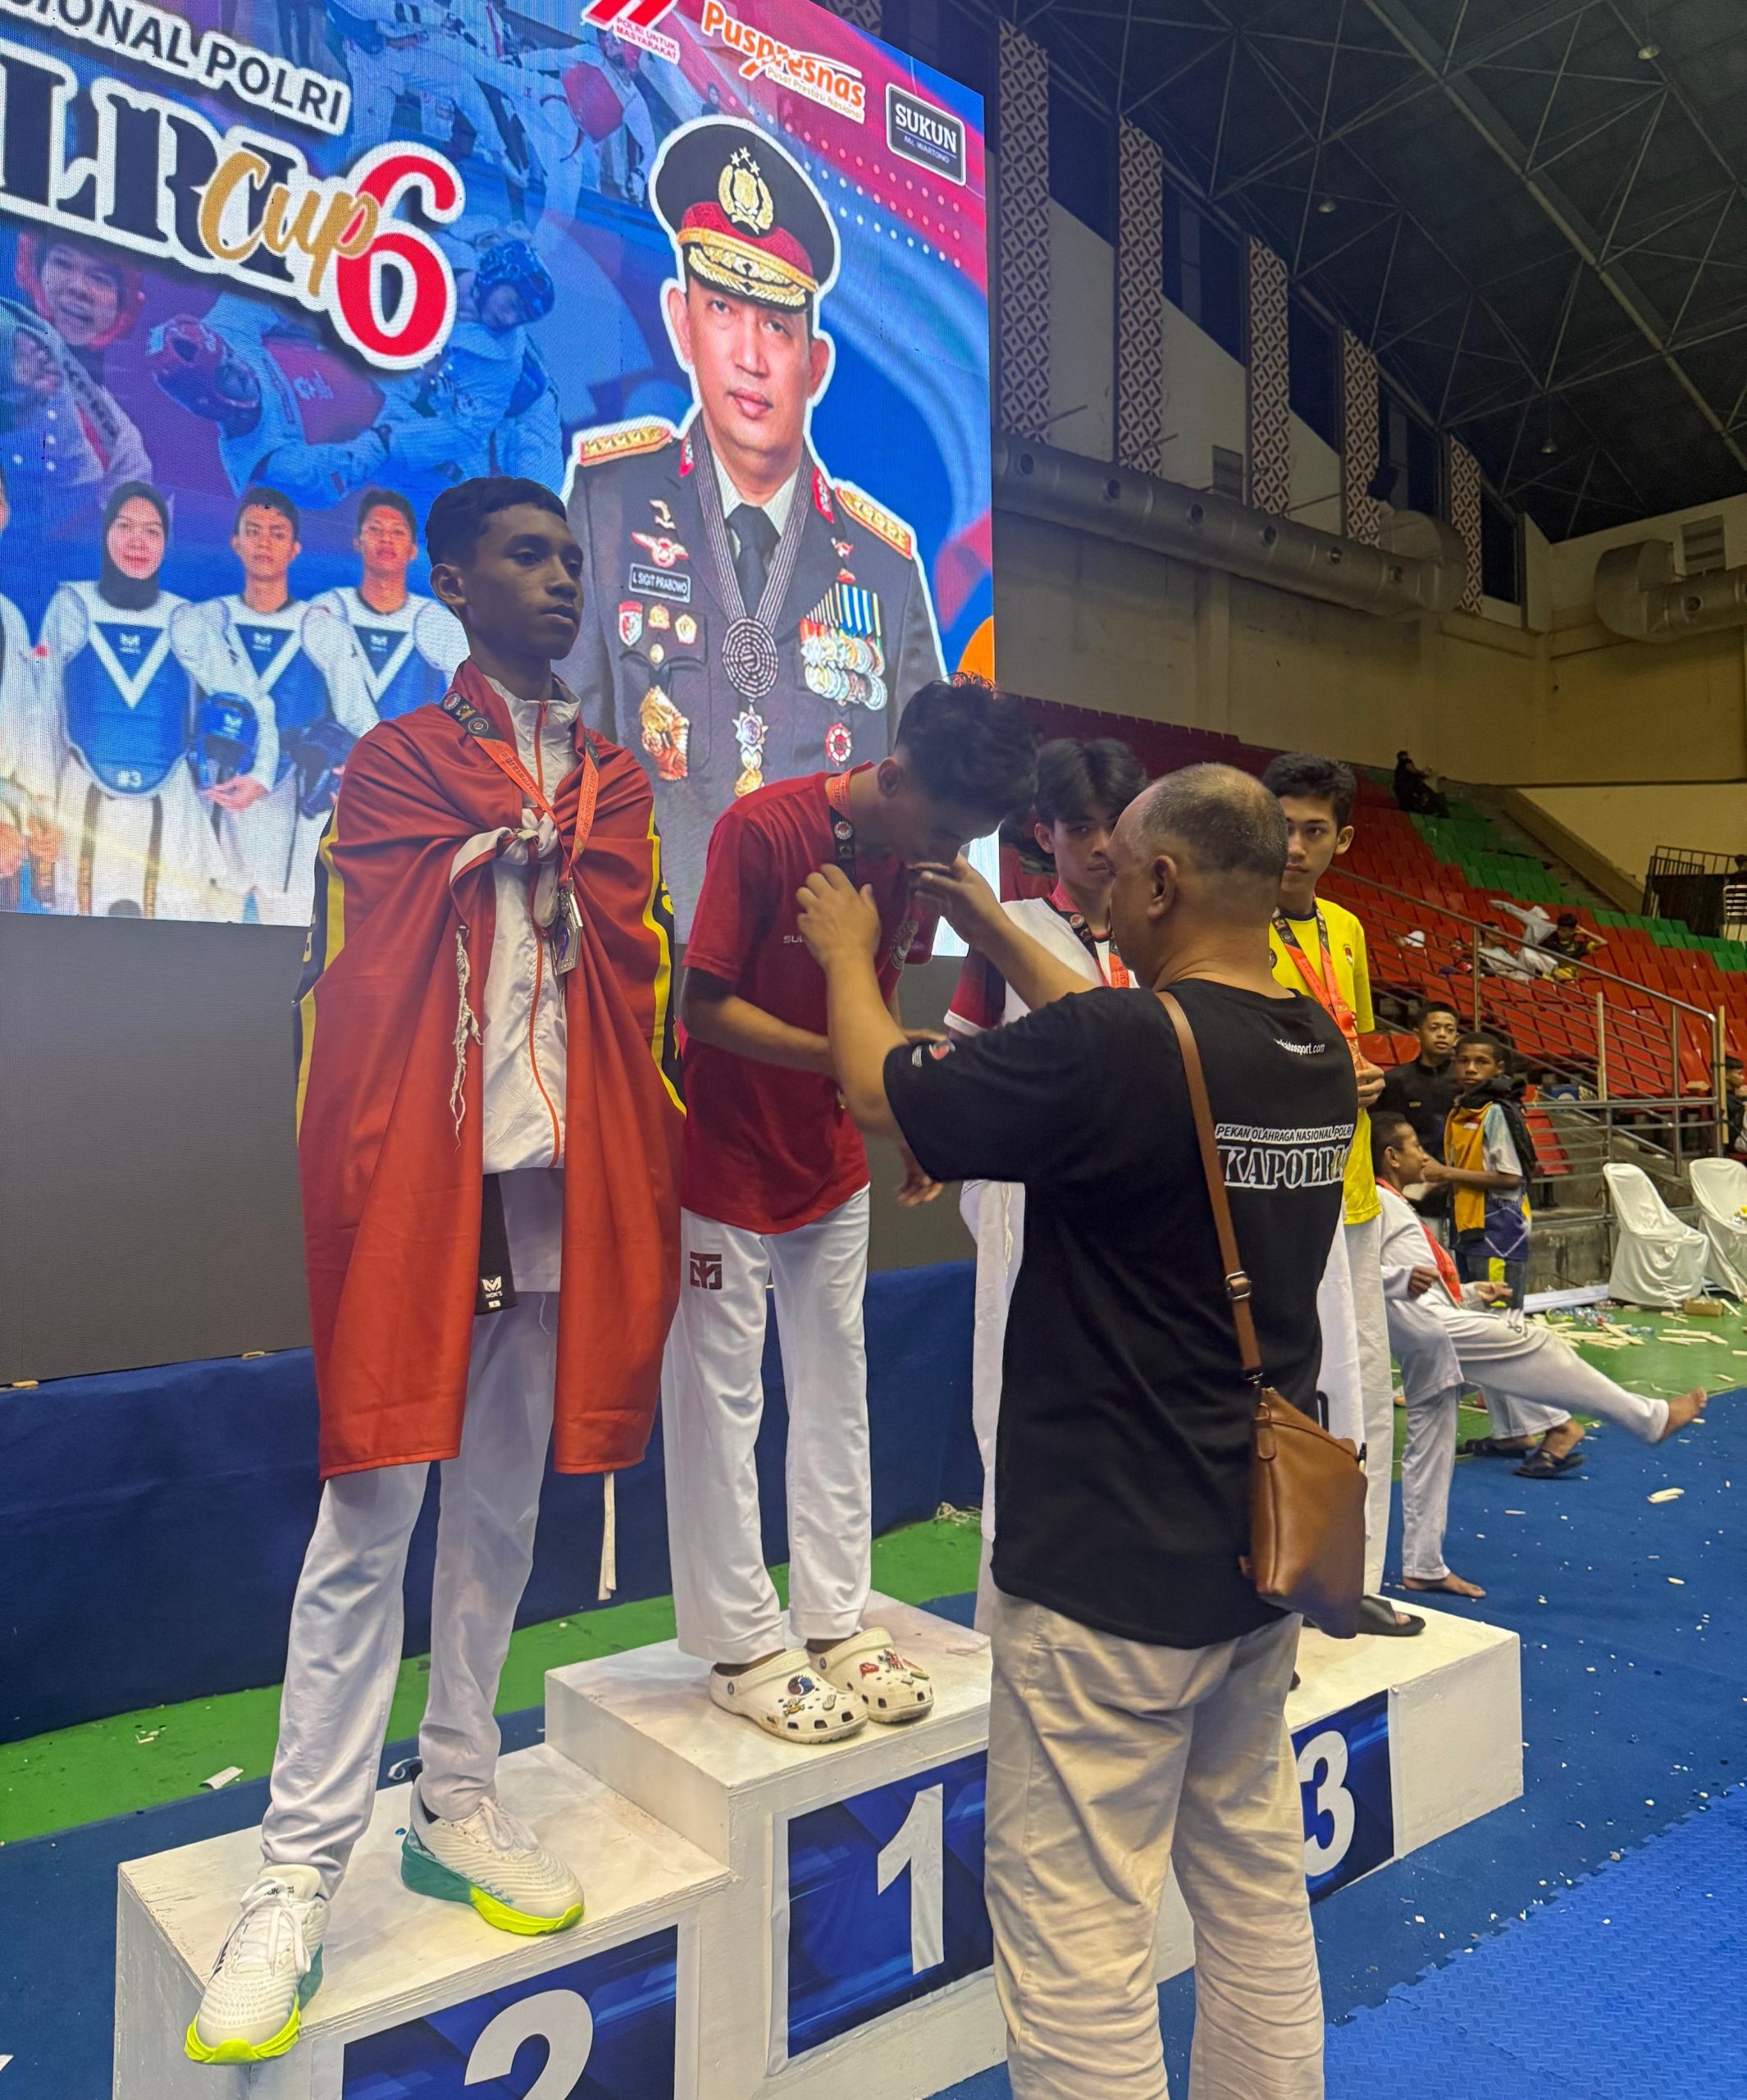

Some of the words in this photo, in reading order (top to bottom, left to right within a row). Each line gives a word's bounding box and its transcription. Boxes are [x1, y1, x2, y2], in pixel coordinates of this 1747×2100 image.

[11, 0, 189, 68] ONAL
[206, 41, 344, 126] POLRI
[616, 25, 677, 59] MASYARAKAT
[704, 1, 862, 107] Puspresnas
[895, 103, 958, 154] SUKUN
[198, 151, 379, 297] Cup
[335, 154, 458, 357] 6
[1216, 1125, 1250, 1139] PEKAN
[1252, 1128, 1294, 1142] OLAHRAGA
[1295, 1126, 1334, 1142] NASIONAL
[1297, 1729, 1356, 1877] 3
[878, 1783, 945, 1975] 1
[463, 1988, 594, 2100] 2
